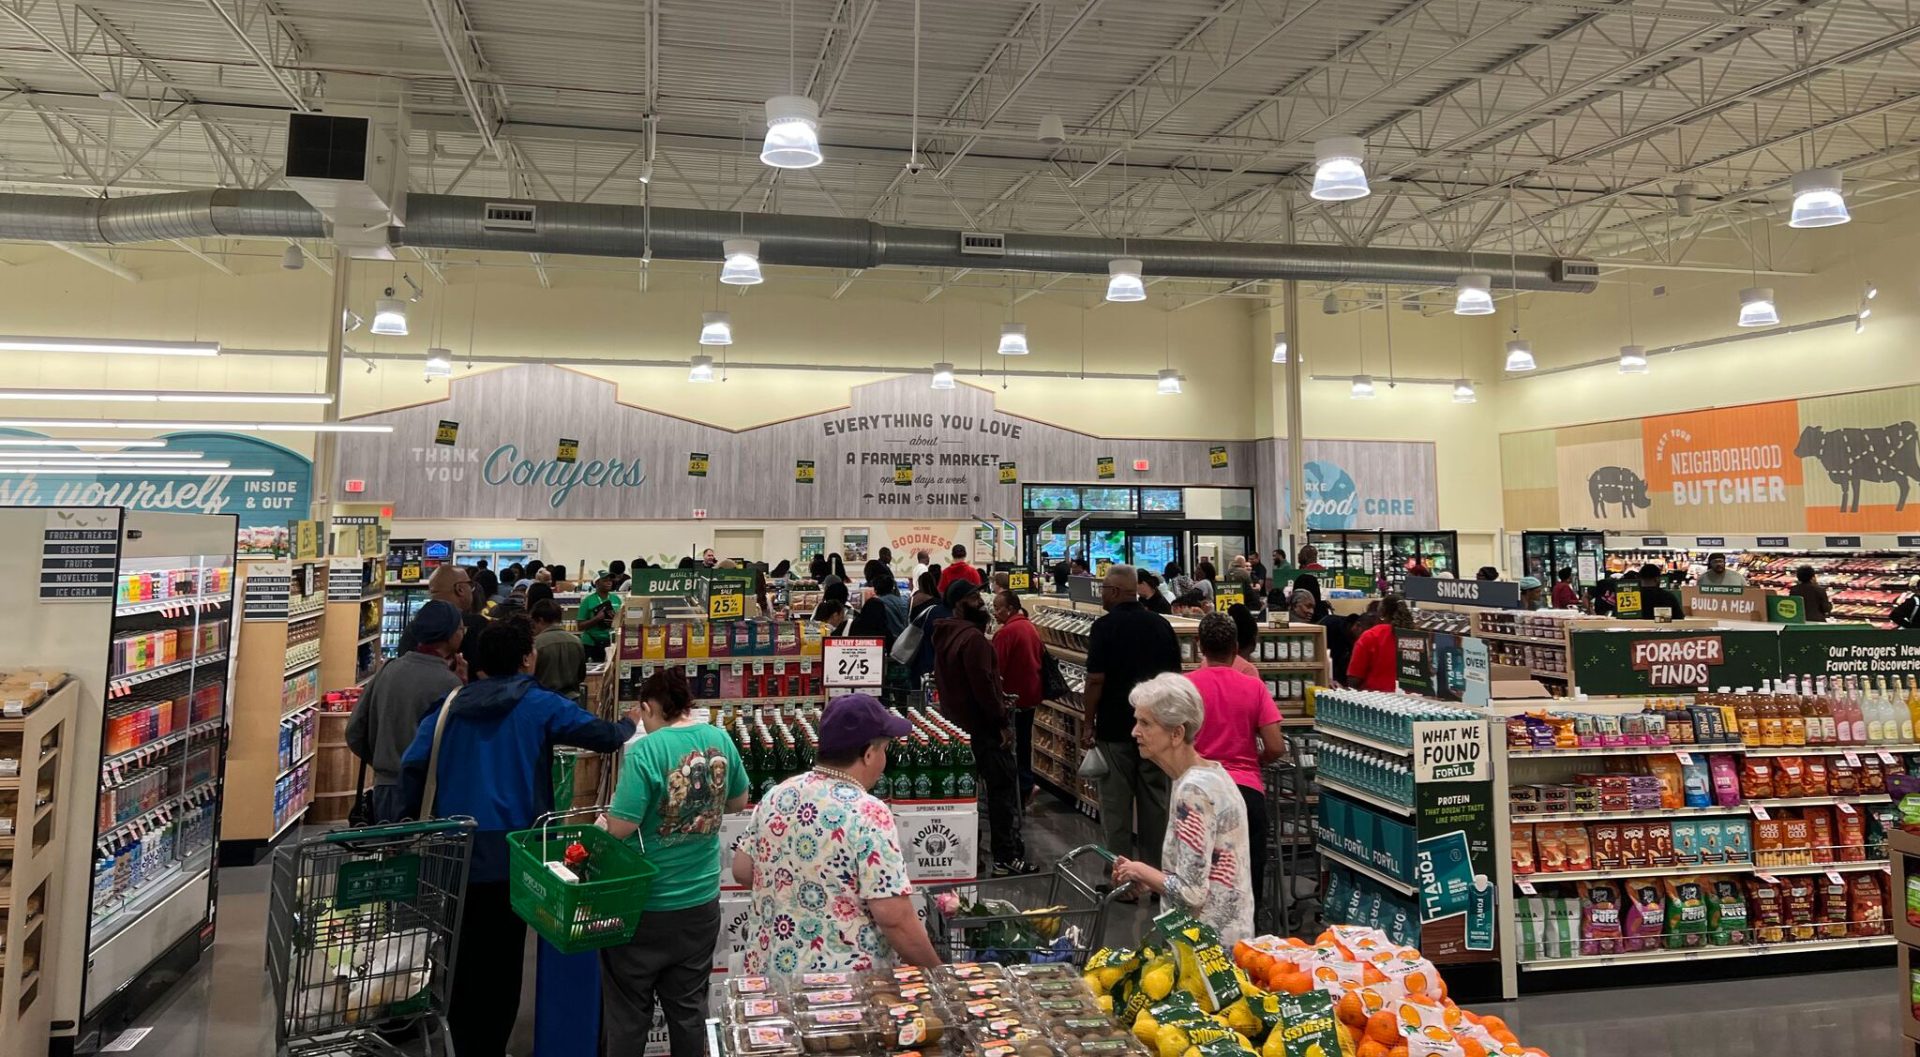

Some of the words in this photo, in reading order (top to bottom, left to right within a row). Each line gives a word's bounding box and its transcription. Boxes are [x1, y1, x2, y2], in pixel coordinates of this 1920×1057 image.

[823, 413, 933, 437] EVERYTHING
[940, 414, 973, 431] YOU
[979, 418, 1022, 440] LOVE
[909, 434, 938, 446] about
[1656, 433, 1668, 463] MEET
[1670, 428, 1692, 443] YOUR
[412, 447, 480, 462] THANK
[846, 452, 856, 465] A
[861, 452, 934, 466] FARMER'S
[939, 453, 1000, 467] MARKET
[1671, 444, 1783, 476] NEIGHBORHOOD
[425, 467, 464, 482] YOU
[483, 443, 647, 509] Conyers
[914, 474, 935, 488] days
[945, 473, 967, 484] week
[244, 480, 298, 494] INSIDE
[1305, 482, 1328, 492] AKE
[1672, 475, 1787, 506] BUTCHER
[53, 474, 232, 514] yourself
[878, 493, 911, 505] RAIN
[926, 493, 968, 505] SHINE
[246, 497, 256, 509] &
[262, 497, 294, 509] OUT
[1364, 498, 1415, 516] CARE
[49, 531, 80, 540] FROZEN
[83, 531, 113, 540] TREATS
[891, 534, 953, 550] GOODNESS
[60, 545, 100, 554] DESSERTS
[64, 559, 93, 568] FRUITS
[56, 573, 99, 582] NOVELTIES
[649, 579, 679, 592] BULK
[1437, 581, 1479, 600] SNACKS
[55, 588, 69, 597] ICE
[70, 588, 97, 597] CREAM
[1691, 597, 1718, 611] BUILD
[1721, 600, 1728, 612] A
[1635, 639, 1720, 664] FORAGER
[1829, 645, 1848, 658] Our
[1465, 657, 1486, 670] OVER!
[1826, 659, 1868, 672] Favorite
[1651, 663, 1708, 686] FINDS
[1422, 728, 1457, 744] WHAT
[1461, 726, 1480, 740] WE
[1423, 742, 1480, 765] FOUND
[1437, 794, 1471, 806] PROTEIN
[1425, 807, 1440, 816] THAT
[1467, 803, 1484, 812] TASTE
[1435, 815, 1448, 824] LIKE
[1450, 813, 1475, 823] PROTEIN
[1759, 823, 1779, 831] MADE
[1787, 823, 1807, 831] MADE
[912, 824, 960, 847] MOUNTAIN
[1759, 830, 1779, 839] GOOD
[1787, 830, 1807, 839] GOOD
[917, 857, 954, 867] VALLEY
